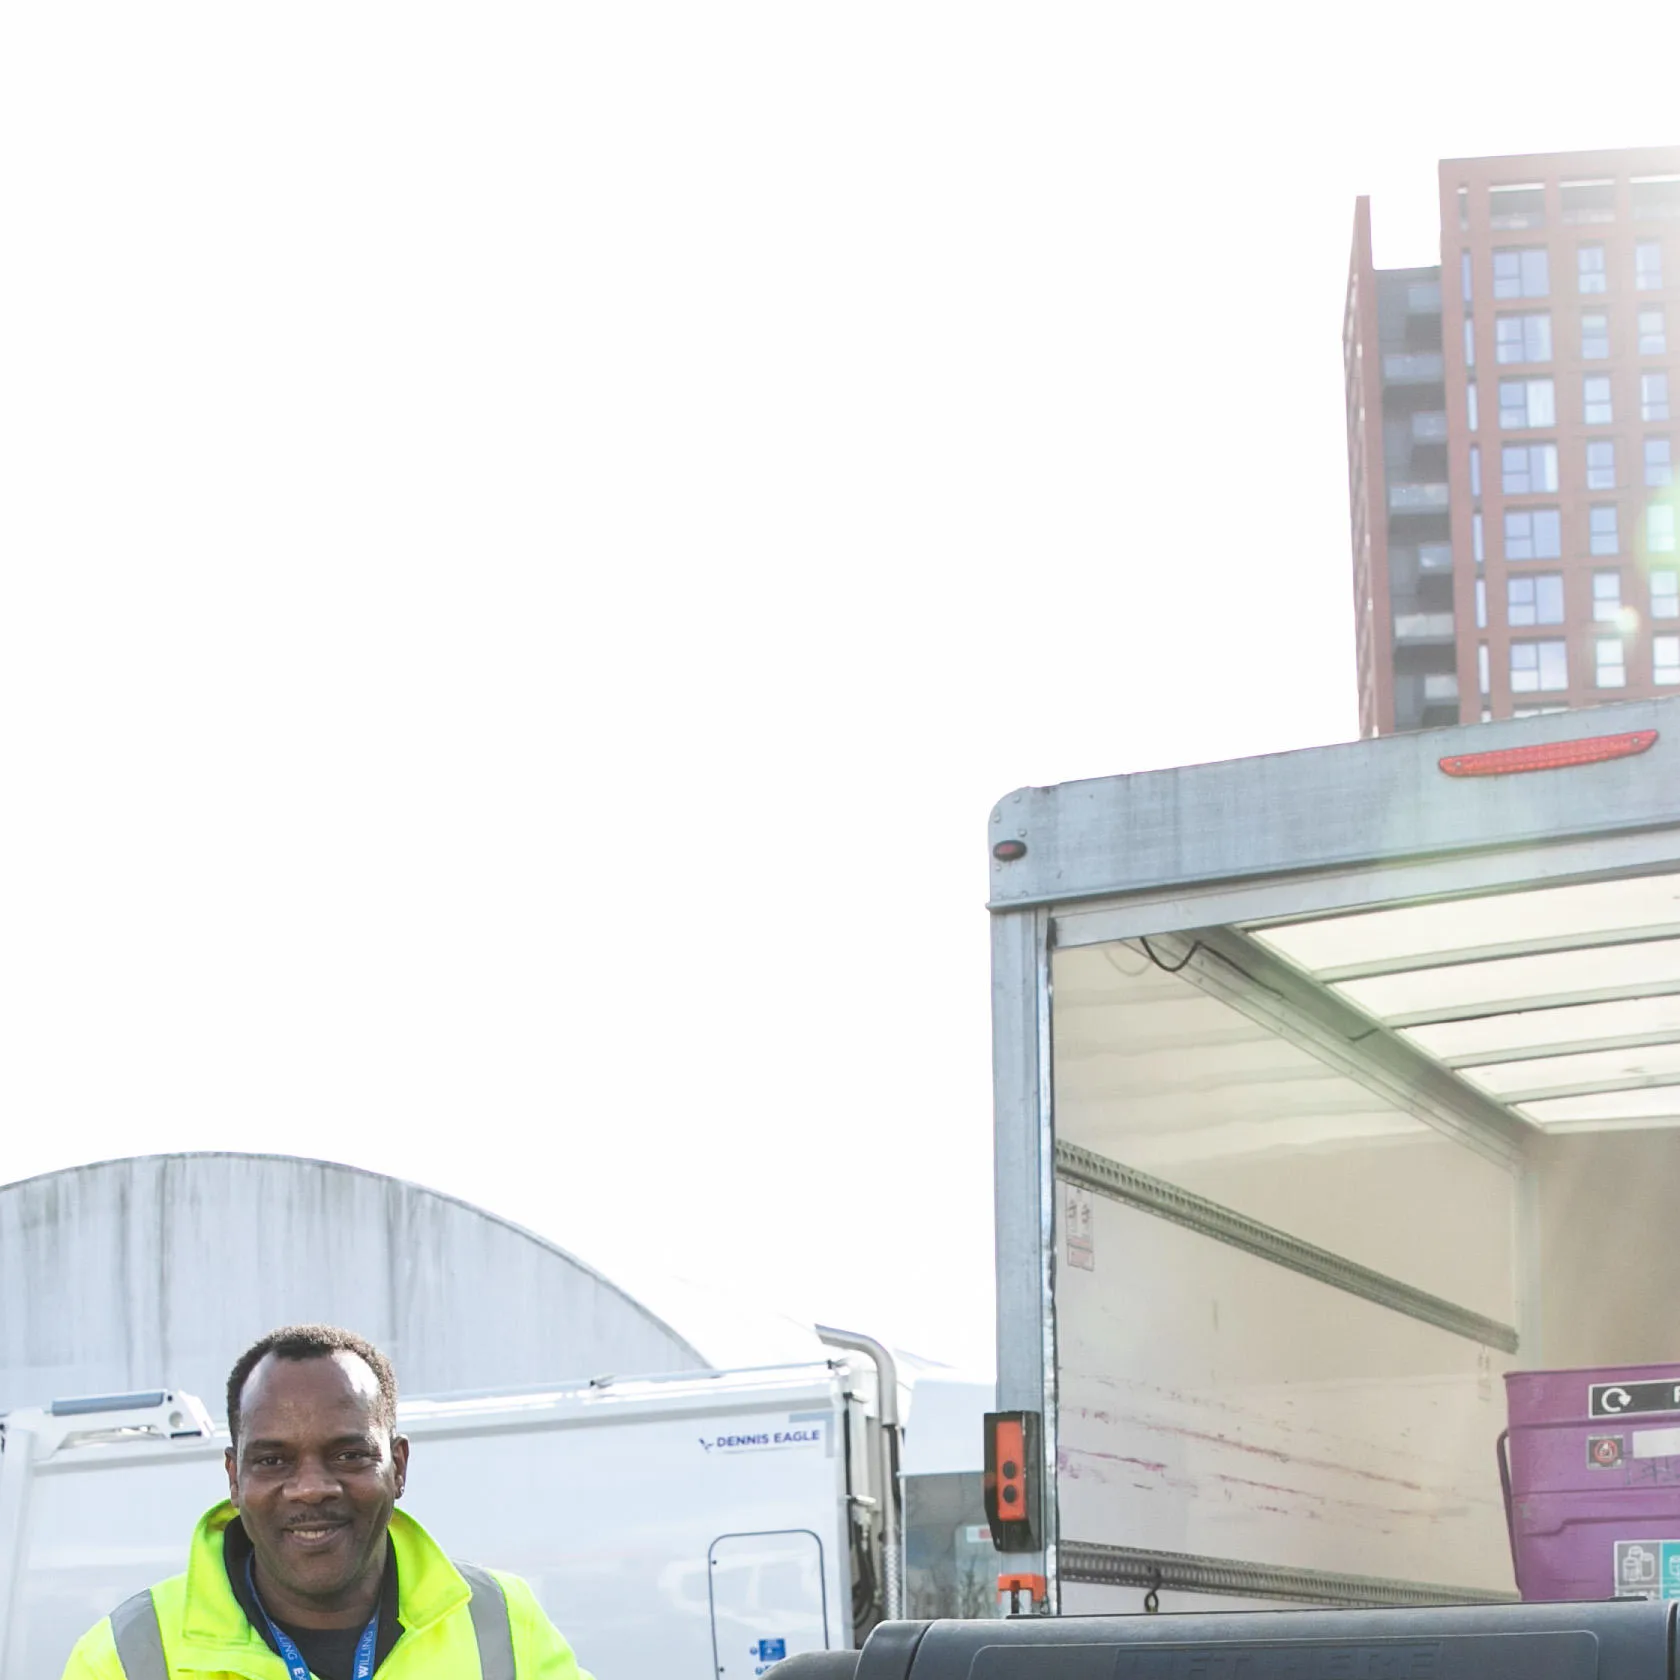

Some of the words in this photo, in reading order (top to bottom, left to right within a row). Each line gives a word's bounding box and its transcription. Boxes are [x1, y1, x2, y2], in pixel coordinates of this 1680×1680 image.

[716, 1434, 769, 1448] DENNIS
[773, 1430, 820, 1443] EAGLE
[357, 1631, 373, 1679] WILLING
